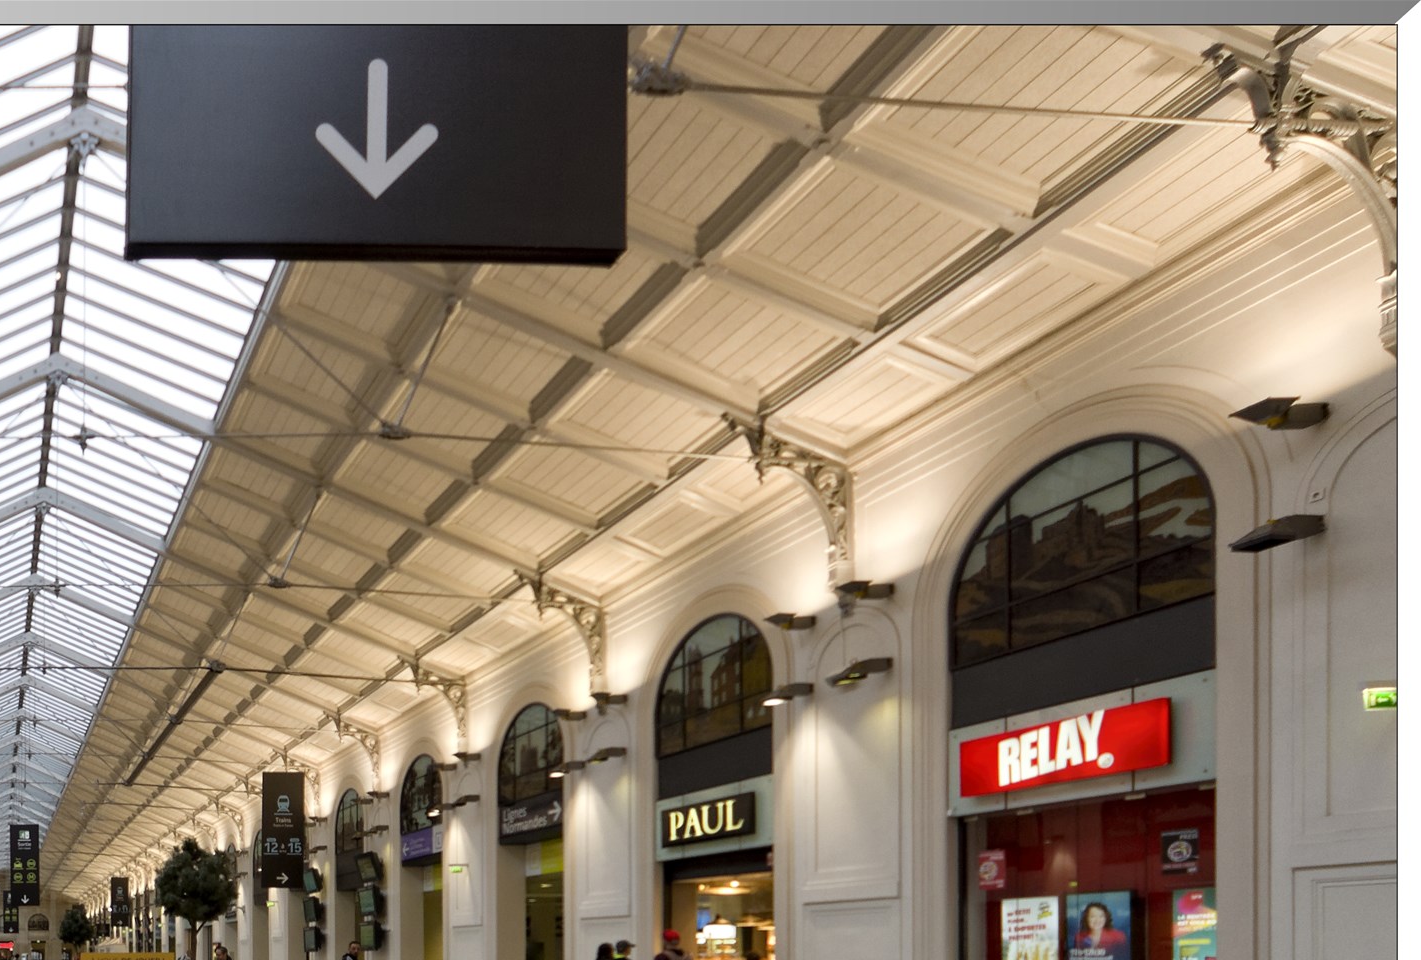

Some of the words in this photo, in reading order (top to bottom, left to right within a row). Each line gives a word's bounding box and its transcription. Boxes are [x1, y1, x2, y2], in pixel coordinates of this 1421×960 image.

[998, 709, 1106, 787] RELAY
[502, 815, 548, 835] Normandes
[503, 807, 528, 824] Lignes
[669, 799, 745, 841] PAUL
[264, 842, 279, 853] 12
[288, 842, 302, 853] 15
